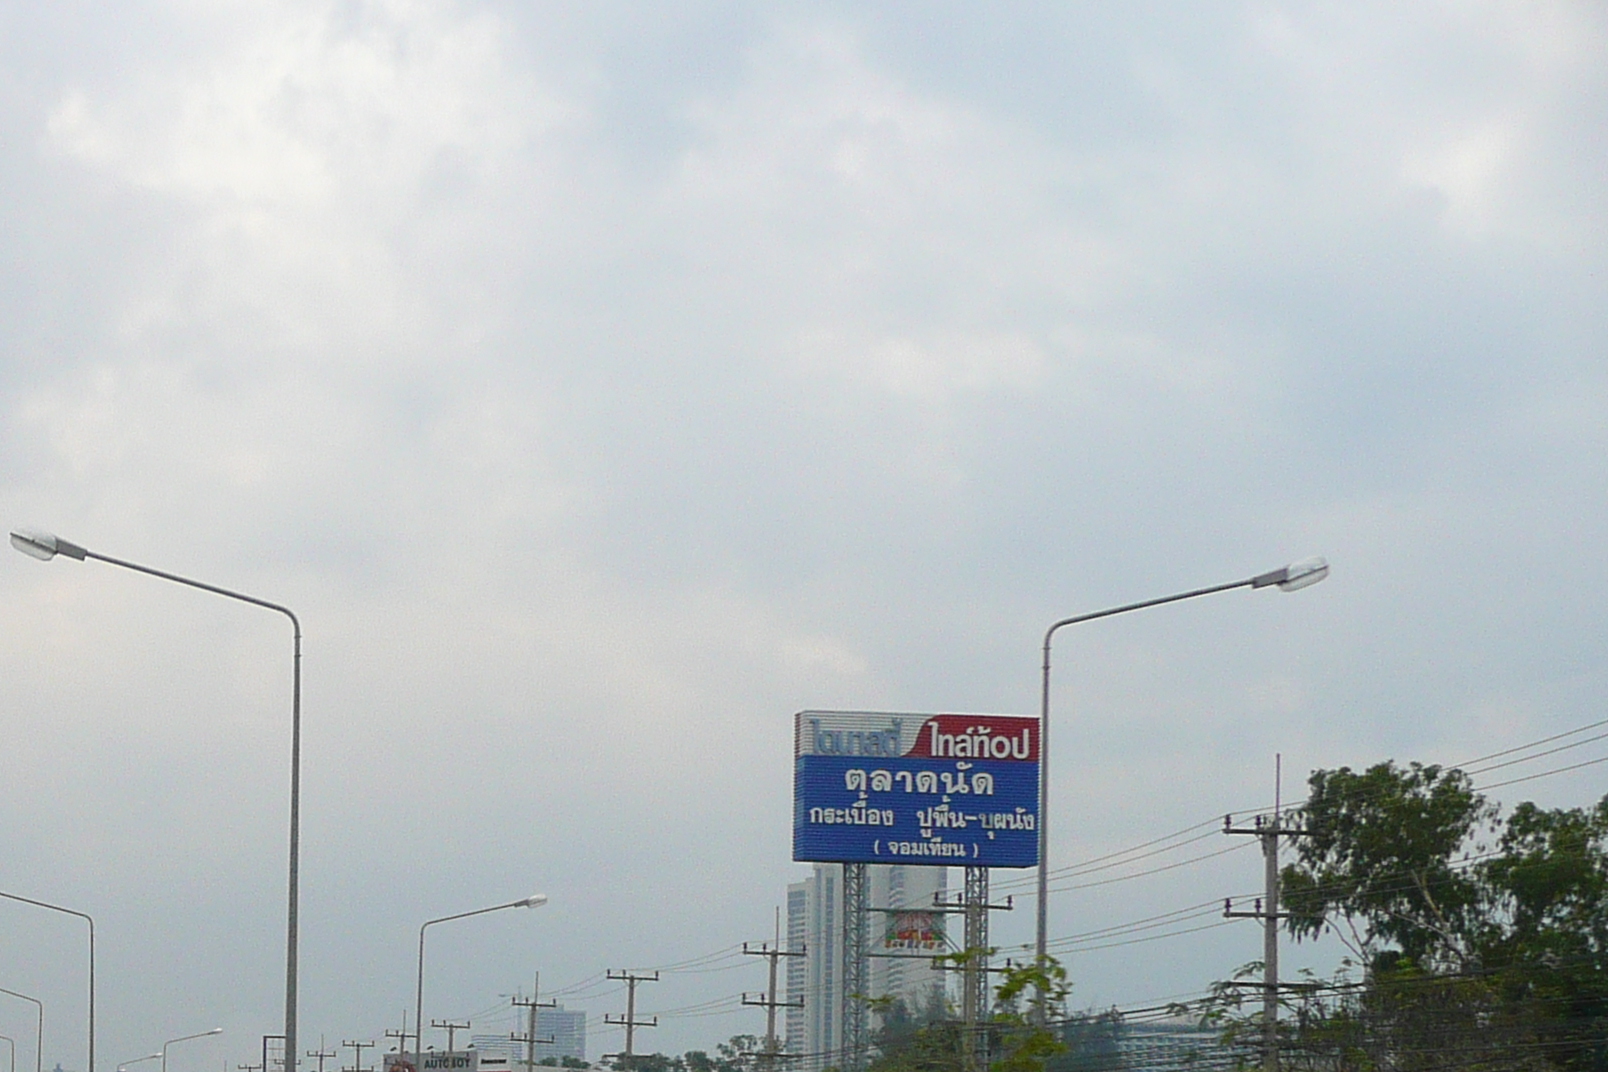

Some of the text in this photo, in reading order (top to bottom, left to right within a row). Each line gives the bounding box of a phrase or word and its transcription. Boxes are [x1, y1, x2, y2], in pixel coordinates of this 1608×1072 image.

[927, 721, 1031, 760] ไทล์ท้อป
[844, 761, 995, 796] ตลาดนัด
[808, 792, 895, 827] กระเบื้อง
